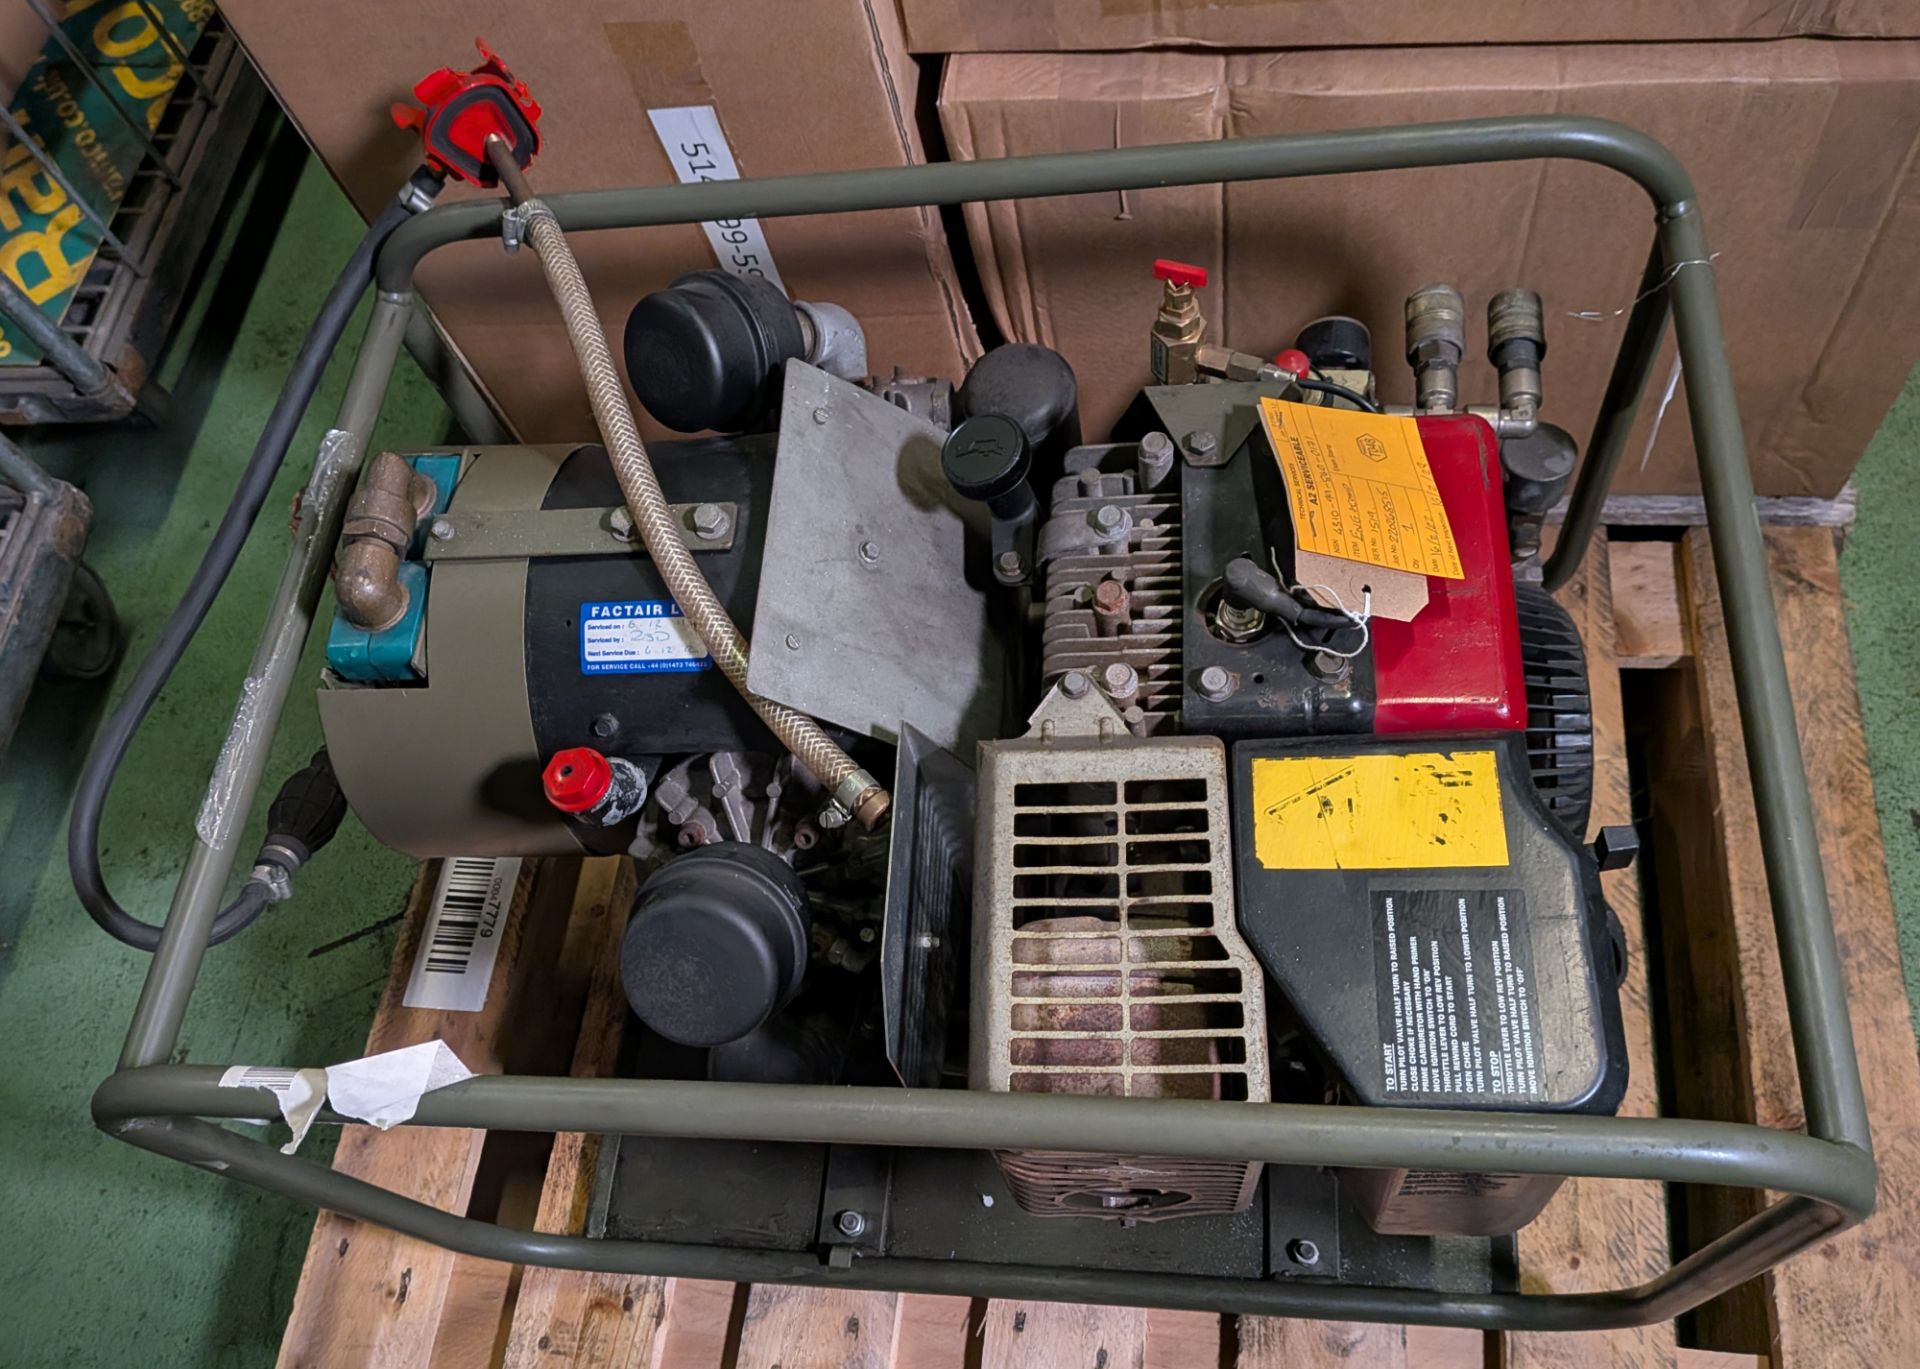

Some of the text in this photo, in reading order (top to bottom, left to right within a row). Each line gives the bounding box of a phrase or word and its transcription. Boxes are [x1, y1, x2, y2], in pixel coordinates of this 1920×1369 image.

[1290, 436, 1318, 505] A2 SERVICEABLE
[1295, 488, 1306, 520] TECHNICAL
[592, 605, 662, 617] FACTAIR
[1386, 898, 1395, 931] POSITION
[1498, 897, 1507, 931] POSITION
[1389, 933, 1397, 960] RAISED
[1431, 941, 1440, 976] POSITION
[1492, 941, 1502, 976] POSITION
[1501, 933, 1510, 960] RAISED
[1391, 962, 1398, 972] TO
[1504, 962, 1512, 972] TO
[1424, 986, 1432, 997] TO
[1459, 899, 1484, 1093] TURN PILOT VALVE HALF TURN TO LOWER POSITION
[1506, 975, 1515, 996] TURN
[1518, 987, 1526, 998] TO
[1394, 996, 1402, 1016] HALF
[1403, 981, 1413, 1026] NECESSARY
[1410, 936, 1429, 1092] PRIME CARBURETOR WITH HAND PRIMER
[1426, 999, 1435, 1029] SWITCH
[1436, 995, 1444, 1012] LOW
[1508, 997, 1517, 1017] HALF
[1520, 1000, 1529, 1030] SWITCH
[1395, 1018, 1404, 1043] VALVE
[1438, 1014, 1445, 1025] TO
[1500, 1015, 1507, 1025] TO
[1511, 1020, 1520, 1045] VALVE
[1439, 1027, 1448, 1050] LEVER
[1445, 976, 1462, 1092] PULL REWIND CORD TO START
[1501, 1027, 1510, 1051] LEVER
[1397, 1045, 1406, 1067] PILOT
[1408, 1037, 1416, 1064] CHOKE
[1429, 1031, 1438, 1066] IGNITION
[1514, 1047, 1523, 1069] PILOT
[1524, 1032, 1534, 1068] IGNITION
[1383, 1043, 1395, 1091] TO START
[1410, 1066, 1419, 1092] CLOSE
[1432, 1068, 1440, 1092] MOVE
[1441, 1053, 1451, 1092] THROTTLE
[1462, 1042, 1474, 1093] OPEN CHOKE
[1489, 1051, 1502, 1093] TO STOP
[1504, 1054, 1514, 1094] THROTTLE
[1528, 1070, 1537, 1093] MOVE
